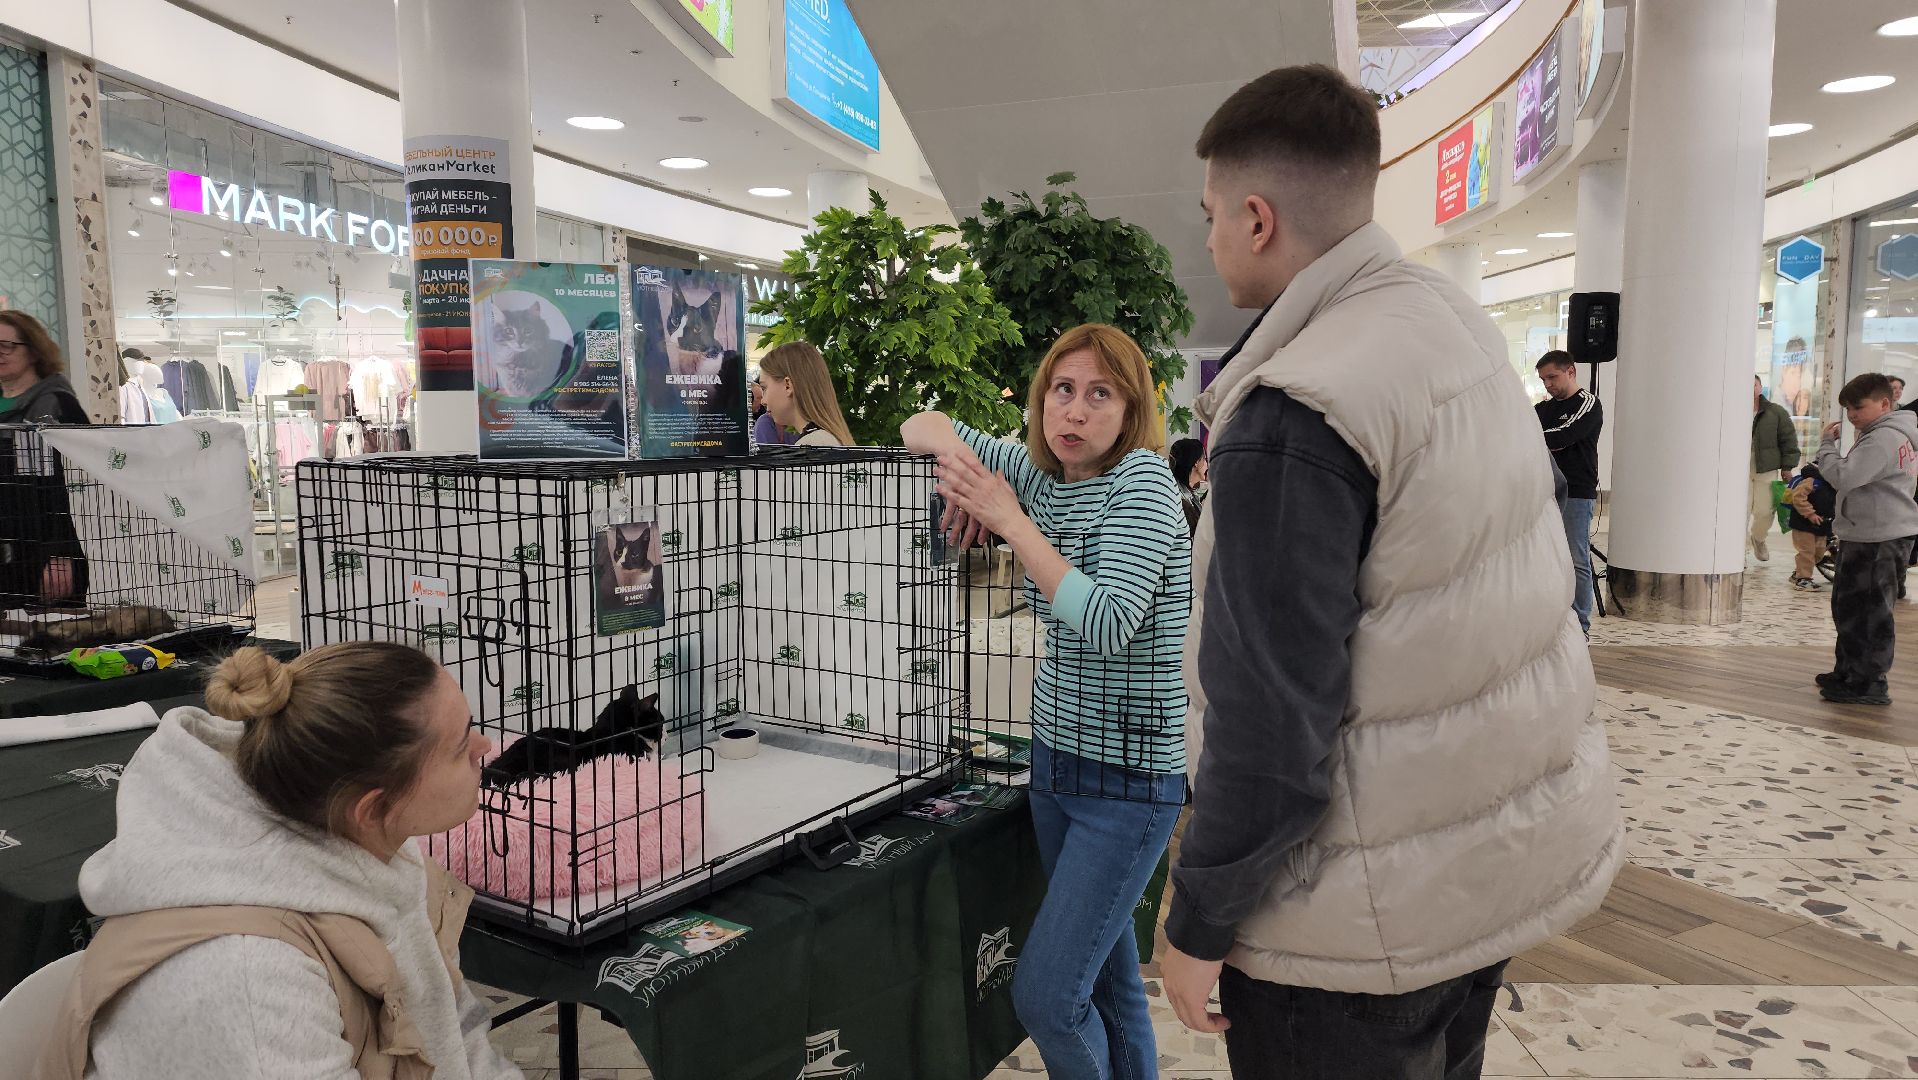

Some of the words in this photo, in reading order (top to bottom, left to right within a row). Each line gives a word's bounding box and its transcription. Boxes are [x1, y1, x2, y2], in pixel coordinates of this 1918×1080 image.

[455, 148, 496, 159] ЦЕНТР
[410, 188, 440, 203] КУПАЙ
[441, 190, 490, 201] МЕБЕЛЬ
[201, 175, 338, 244] MARK
[411, 202, 438, 215] ИГРАЙ
[440, 203, 487, 215] ДЕНЬГИ
[584, 273, 616, 285] ЛЕЯ
[554, 288, 565, 296] 10
[567, 288, 617, 298] МЕСЯЦЕВ
[448, 295, 458, 303] 20
[665, 374, 723, 385] ЕЖЕВИКА
[680, 389, 686, 398] 8
[688, 389, 708, 398] МЕС
[614, 582, 654, 595] ЕЖЕВИКА
